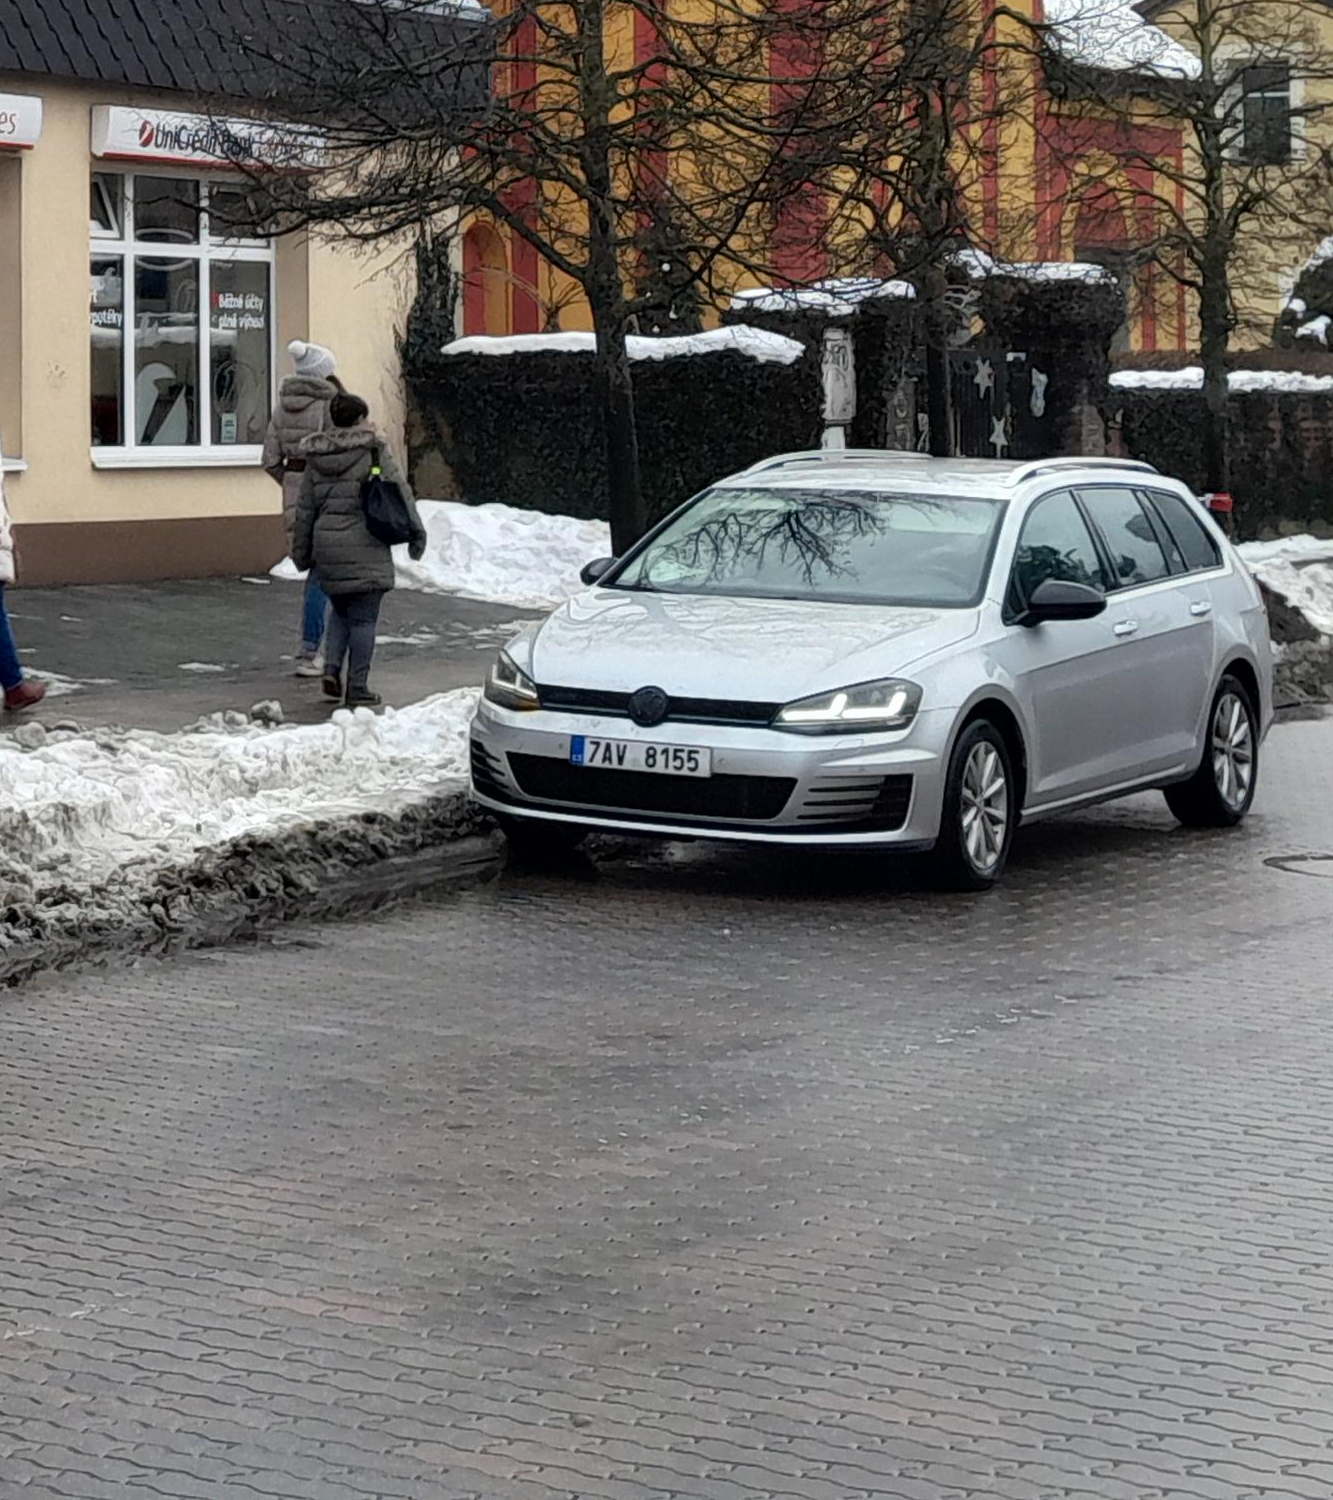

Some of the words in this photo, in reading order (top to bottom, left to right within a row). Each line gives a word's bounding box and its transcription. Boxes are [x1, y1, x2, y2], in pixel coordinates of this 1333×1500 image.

[153, 122, 219, 152] UniCredit
[588, 740, 628, 767] 7AV
[644, 745, 701, 773] 8155
